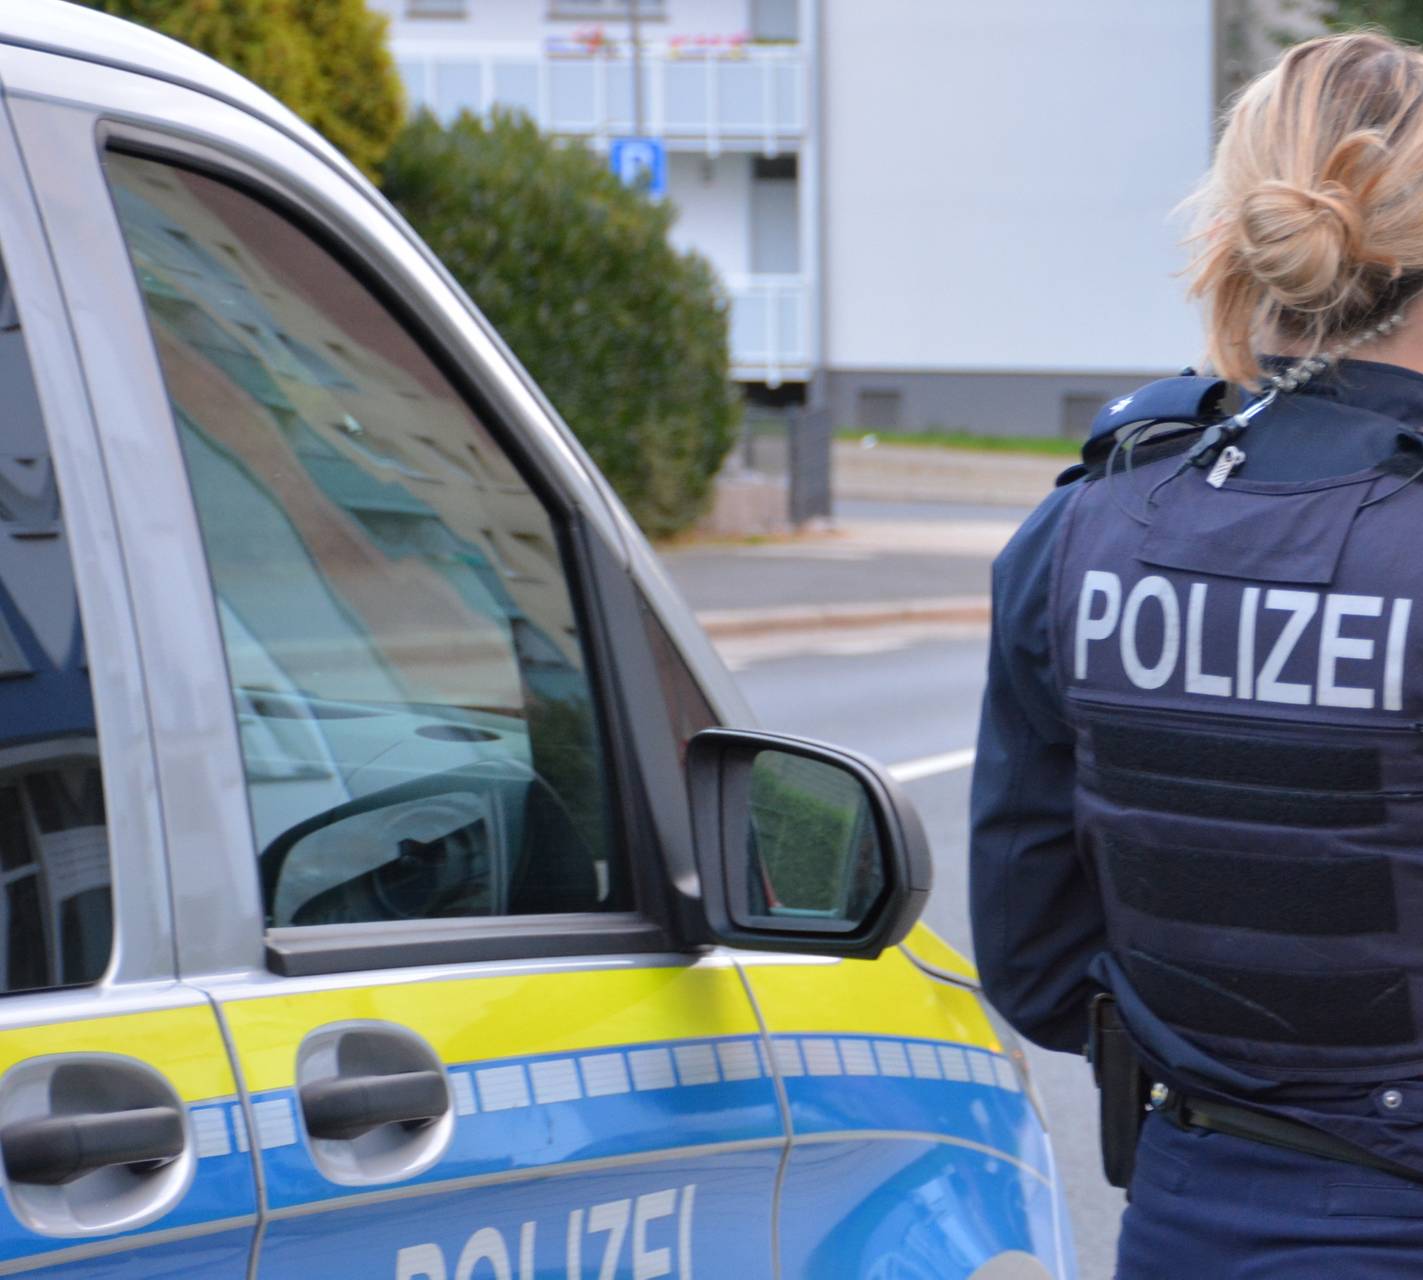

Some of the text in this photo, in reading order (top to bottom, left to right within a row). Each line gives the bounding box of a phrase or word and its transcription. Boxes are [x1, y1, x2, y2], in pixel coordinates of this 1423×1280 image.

[620, 143, 654, 188] P
[1074, 569, 1413, 711] POLIZEI
[395, 1184, 697, 1280] IZEI
